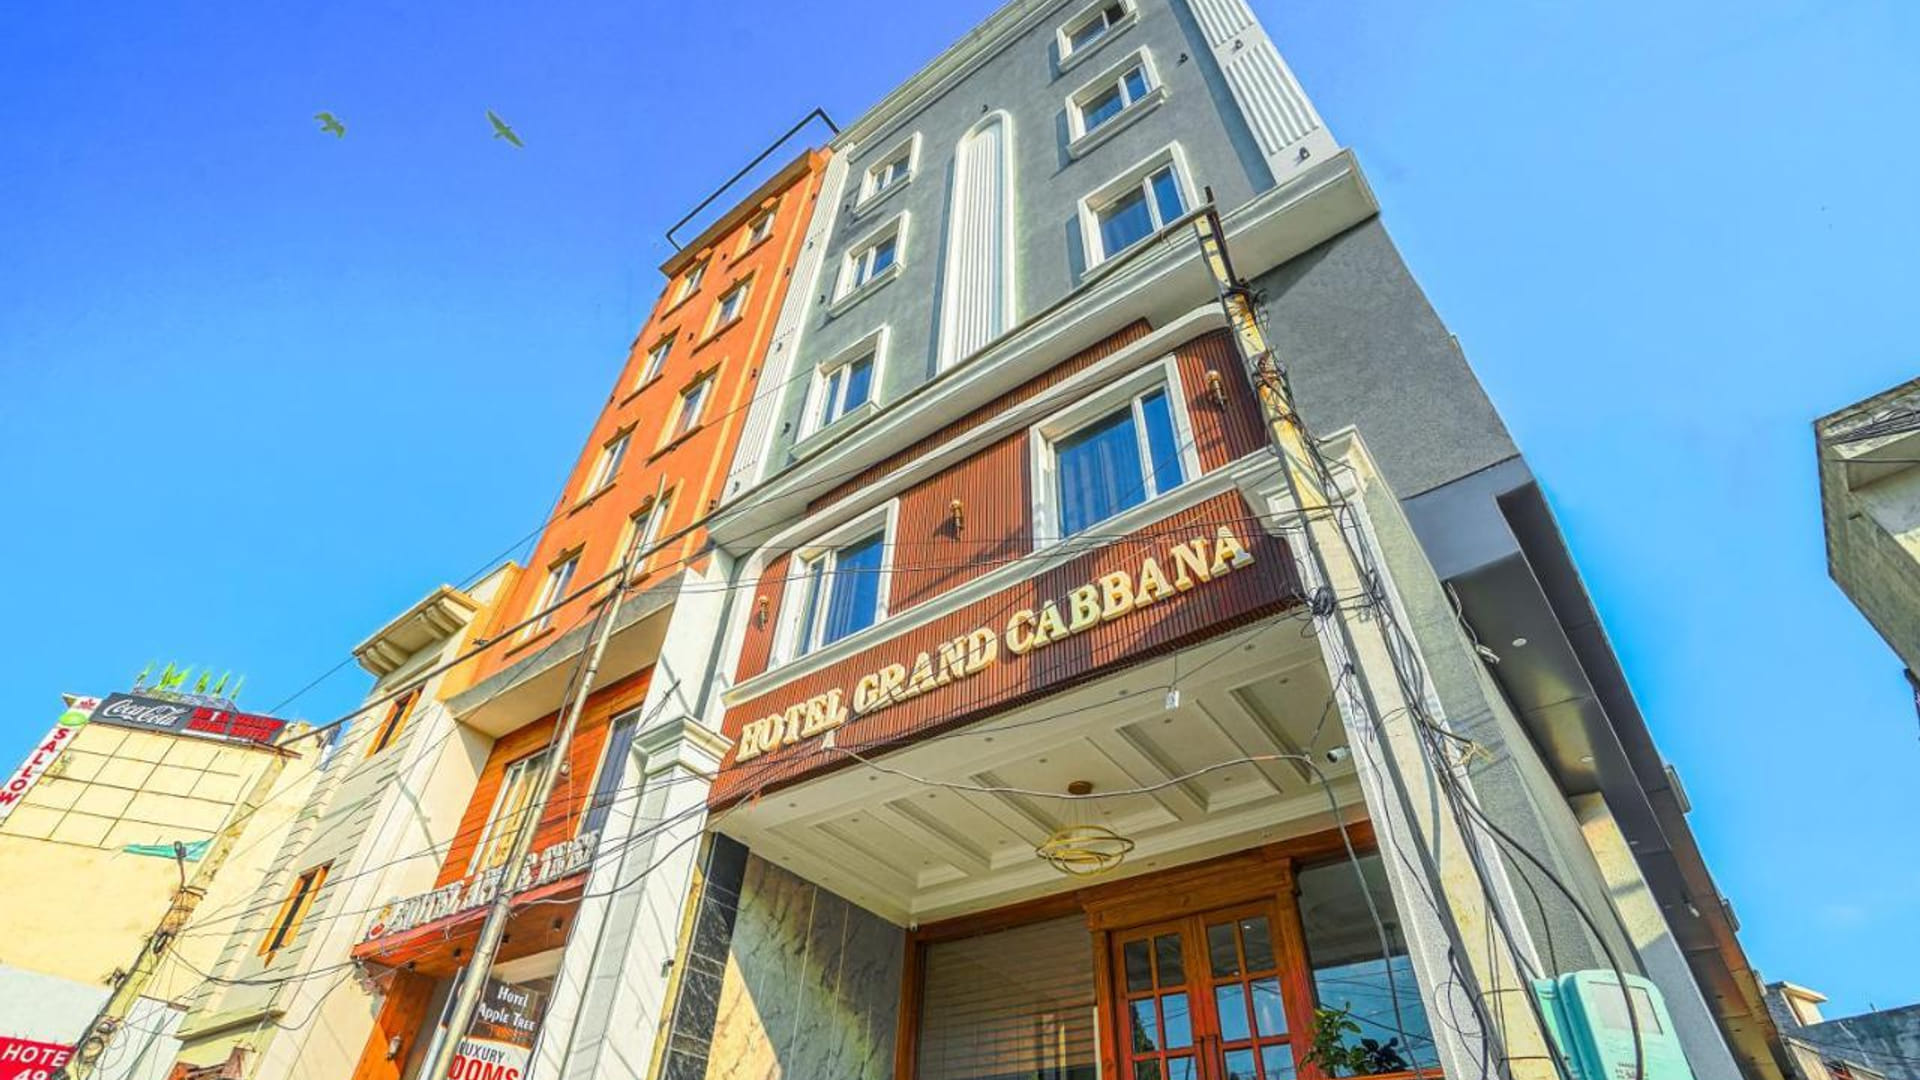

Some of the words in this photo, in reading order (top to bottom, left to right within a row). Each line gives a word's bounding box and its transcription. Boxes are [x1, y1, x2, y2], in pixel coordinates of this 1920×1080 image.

[736, 687, 849, 763] HOTEL
[852, 628, 998, 716] GRAND
[1005, 525, 1256, 656] CABBANA
[1, 1043, 70, 1067] HOTE
